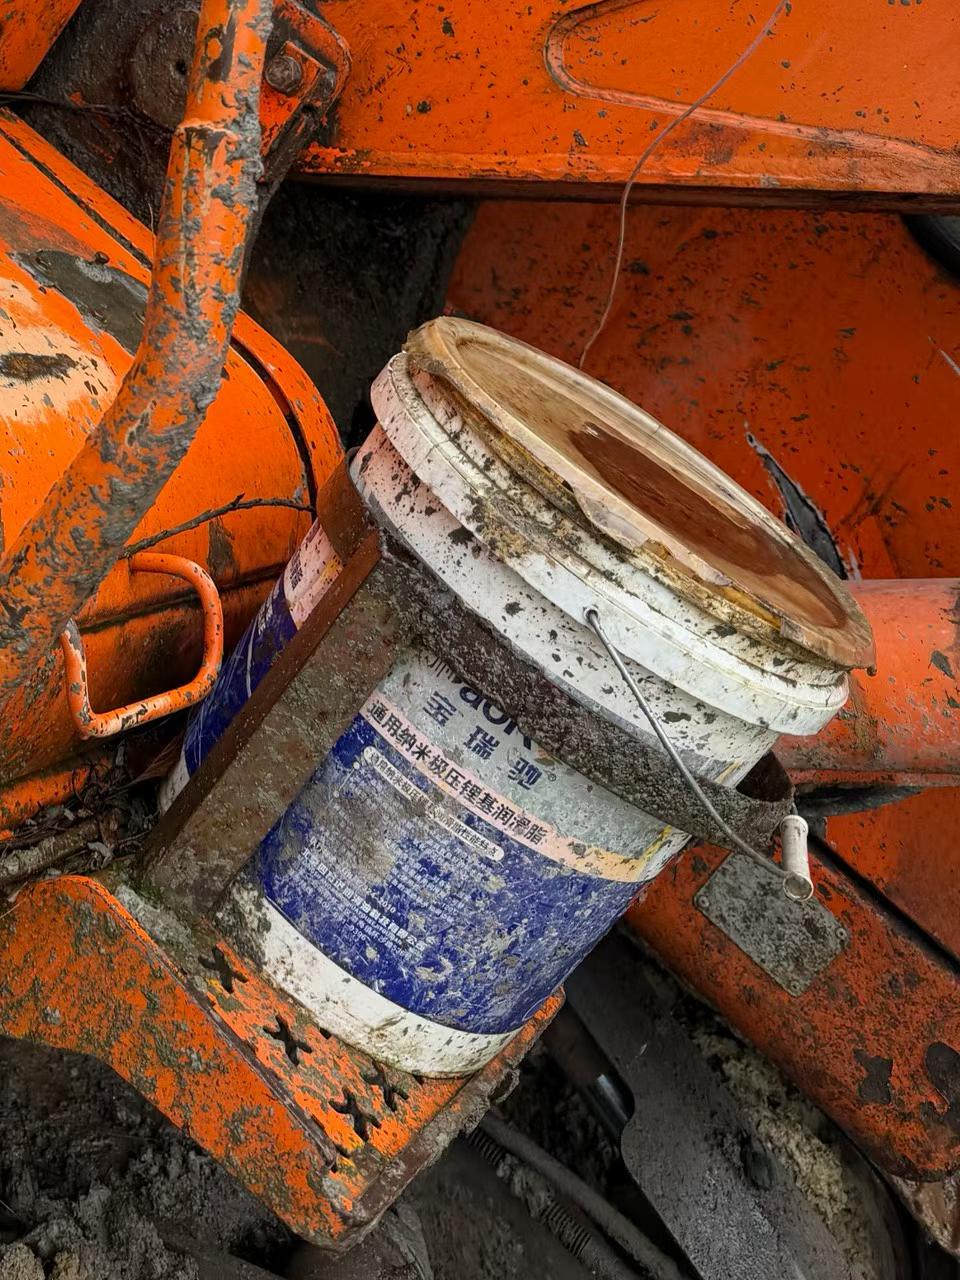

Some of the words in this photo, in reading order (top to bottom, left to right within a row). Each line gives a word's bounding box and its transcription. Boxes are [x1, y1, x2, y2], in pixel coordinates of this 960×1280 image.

[367, 699, 547, 845] 通用纳米极压锂基润滑脂
